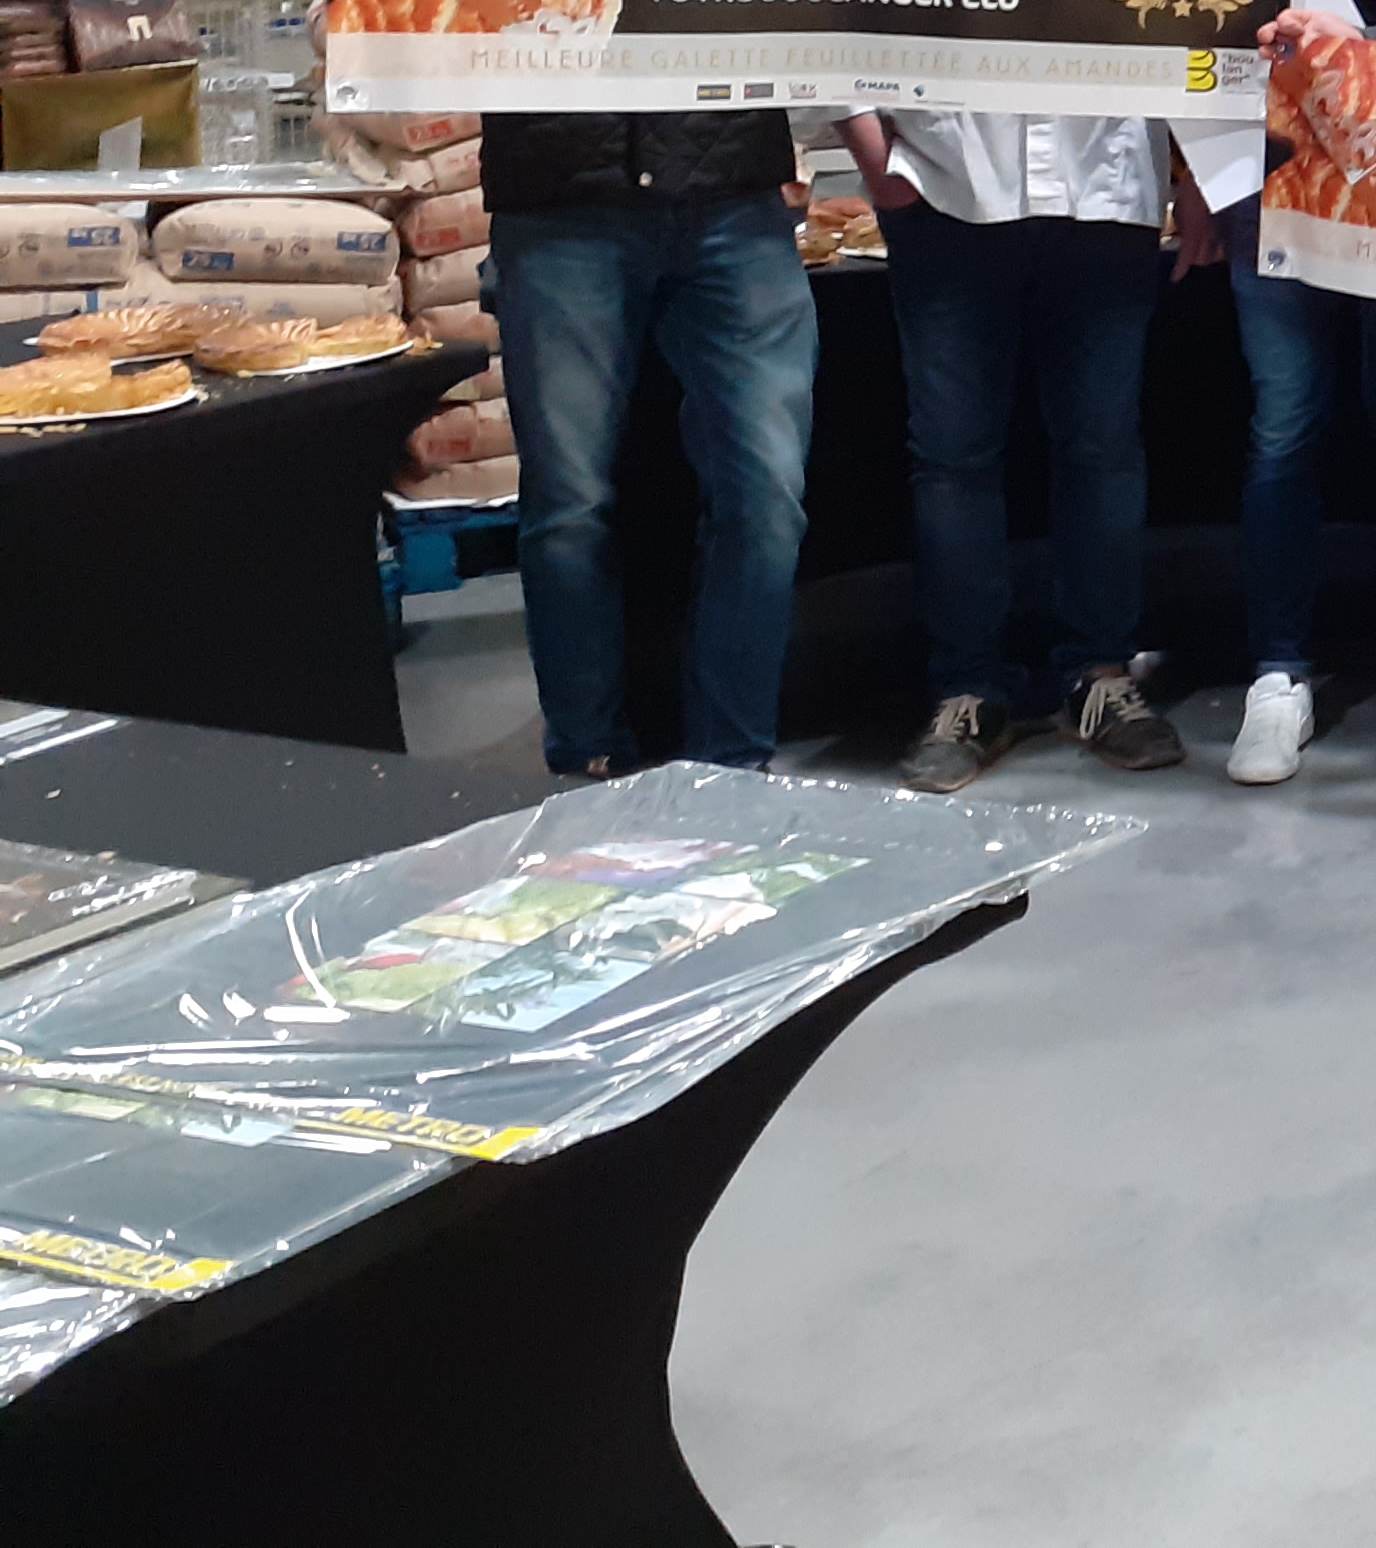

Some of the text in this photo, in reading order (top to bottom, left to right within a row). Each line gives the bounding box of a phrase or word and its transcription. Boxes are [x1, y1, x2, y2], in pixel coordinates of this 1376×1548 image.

[471, 48, 632, 70] MEILLEURE
[651, 49, 775, 70] GALETTE
[976, 53, 1030, 76] AUX
[1045, 55, 1173, 79] AMANDES
[336, 1107, 491, 1144] METRO
